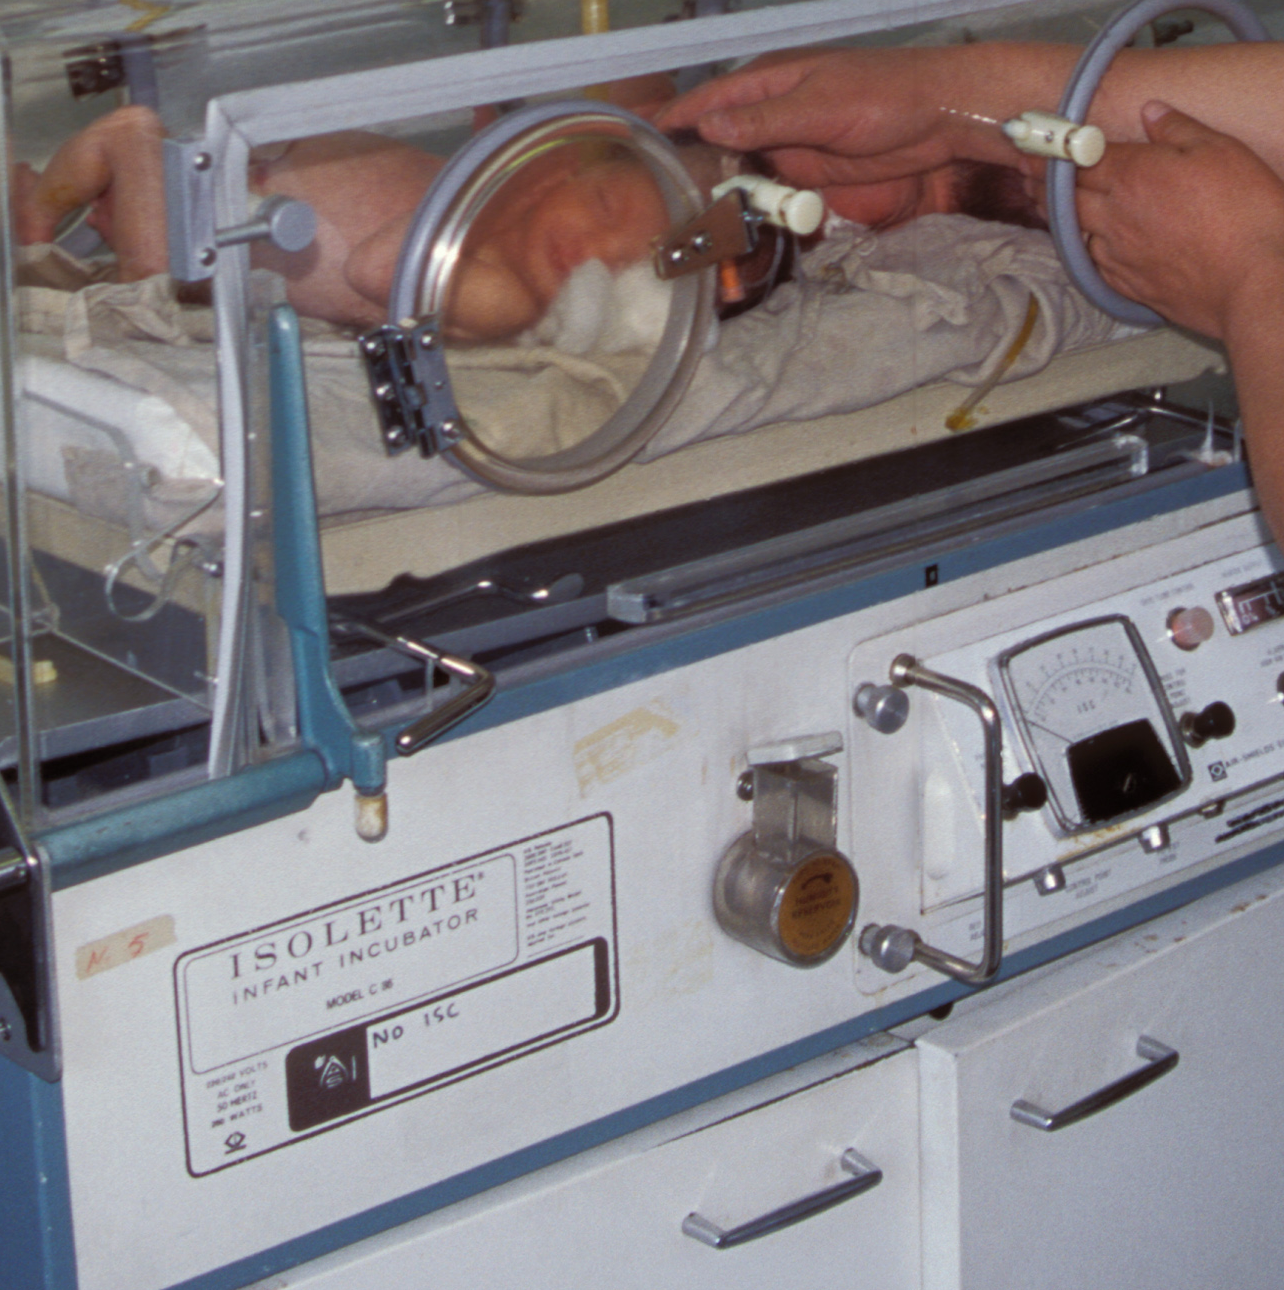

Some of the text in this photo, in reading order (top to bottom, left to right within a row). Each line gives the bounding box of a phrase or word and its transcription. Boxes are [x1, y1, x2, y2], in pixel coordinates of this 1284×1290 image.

[127, 932, 150, 959] 5
[232, 908, 478, 1005] INFANT INCUBATOR
[326, 988, 364, 1009] MODEL
[240, 1061, 268, 1076] VOLTS
[217, 1088, 230, 1099] AC
[230, 1090, 258, 1106] HERTZ
[230, 1104, 263, 1121] WATTS
